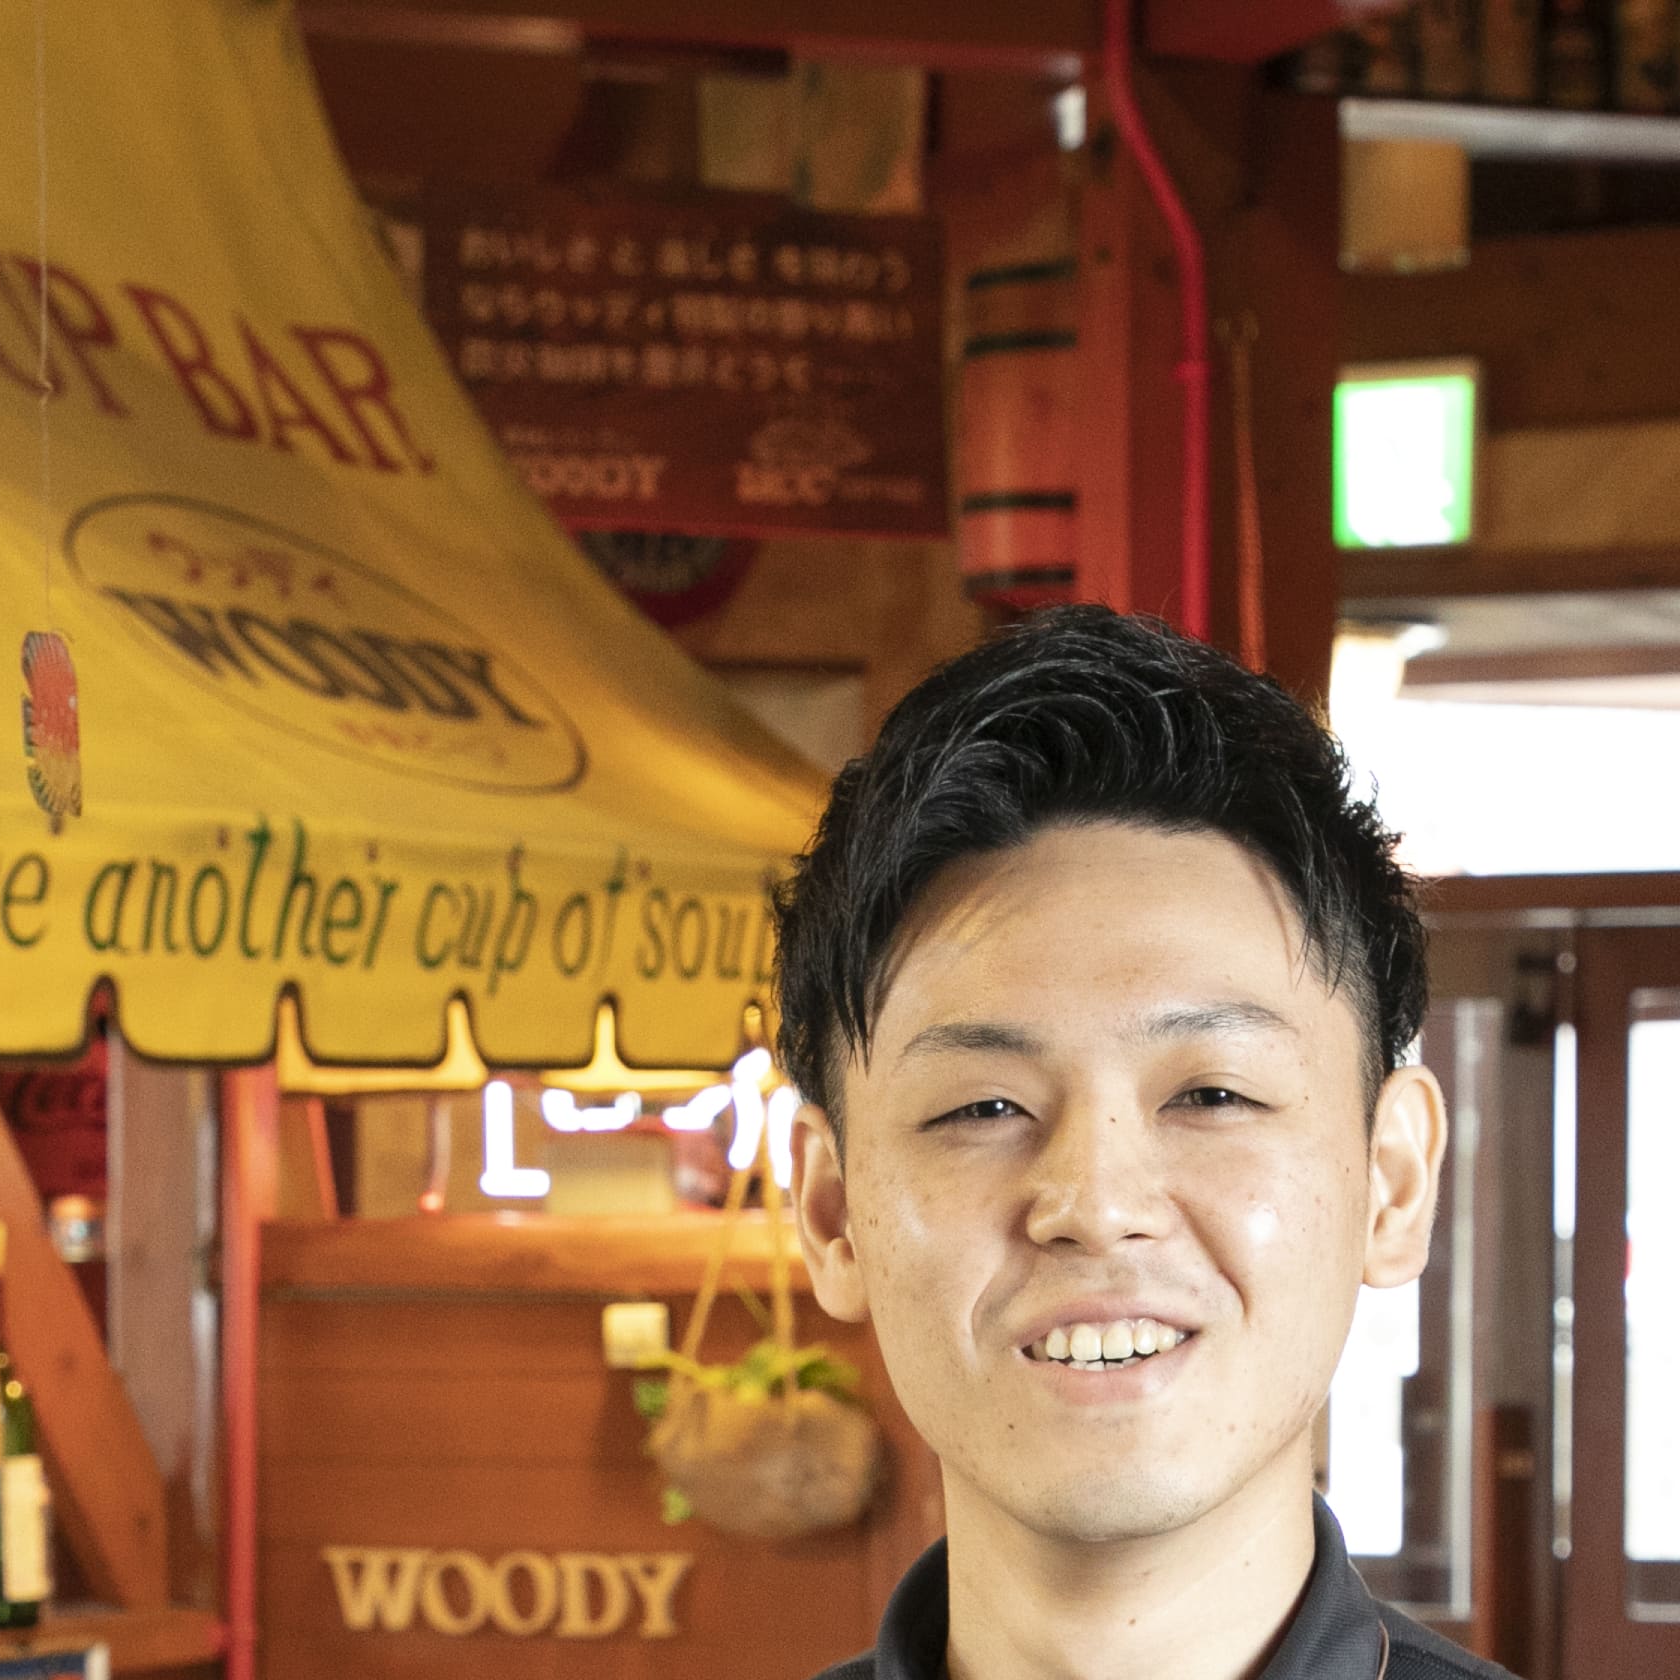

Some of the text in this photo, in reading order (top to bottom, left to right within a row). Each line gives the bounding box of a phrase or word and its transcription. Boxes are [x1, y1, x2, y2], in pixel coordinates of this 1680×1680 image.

[100, 586, 544, 730] WOODY
[84, 810, 400, 970] another
[414, 842, 538, 998] cup
[550, 843, 629, 982] of
[322, 1544, 694, 1640] WOODY
